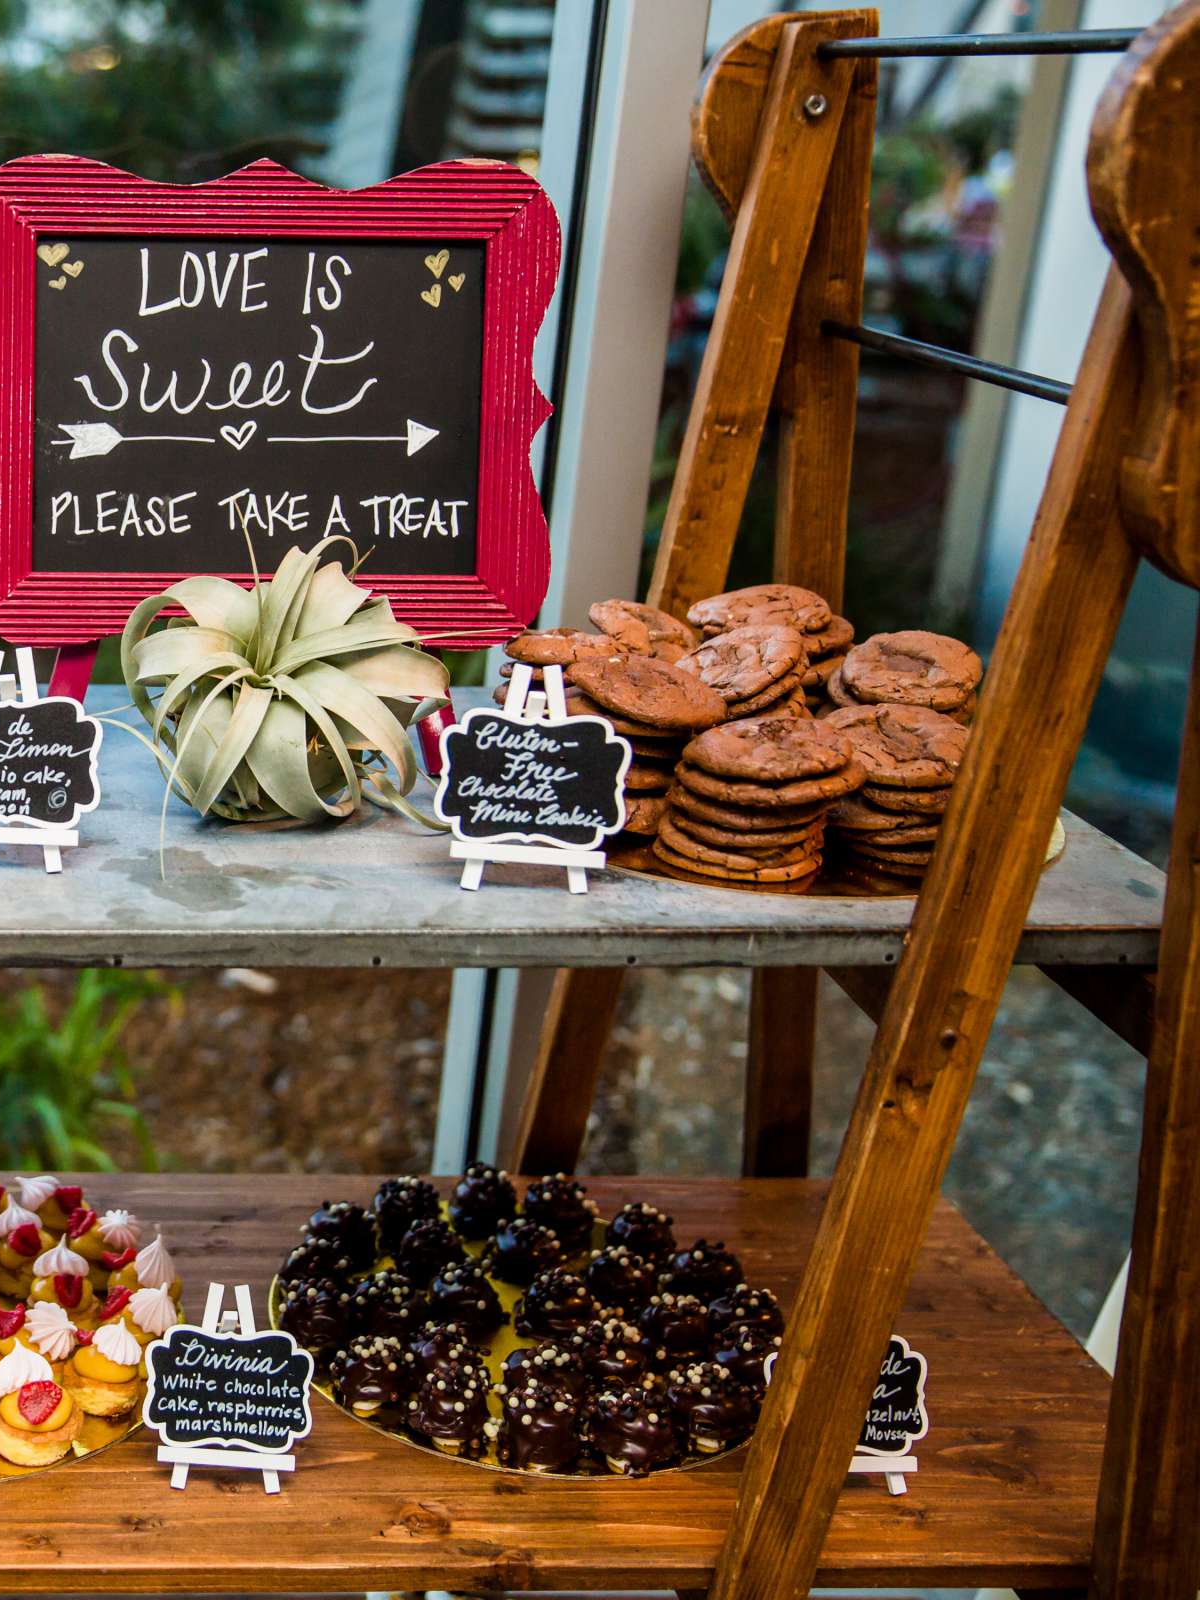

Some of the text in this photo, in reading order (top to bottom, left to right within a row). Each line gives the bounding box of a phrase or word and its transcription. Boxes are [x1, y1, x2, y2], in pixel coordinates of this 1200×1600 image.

[138, 247, 352, 316] LOVE IS
[73, 324, 378, 415] Sweet
[51, 488, 469, 538] PLEASE TAKE A TREAT
[8, 714, 34, 736] de
[23, 765, 72, 787] cake,
[500, 752, 578, 782] Free
[457, 775, 558, 801] Chocolate
[469, 800, 607, 828] Mini Cookie
[175, 1338, 289, 1375] Divinia
[162, 1373, 300, 1398] White chocolate
[207, 1401, 305, 1424] raspberries,
[175, 1418, 290, 1437] marshmellow
